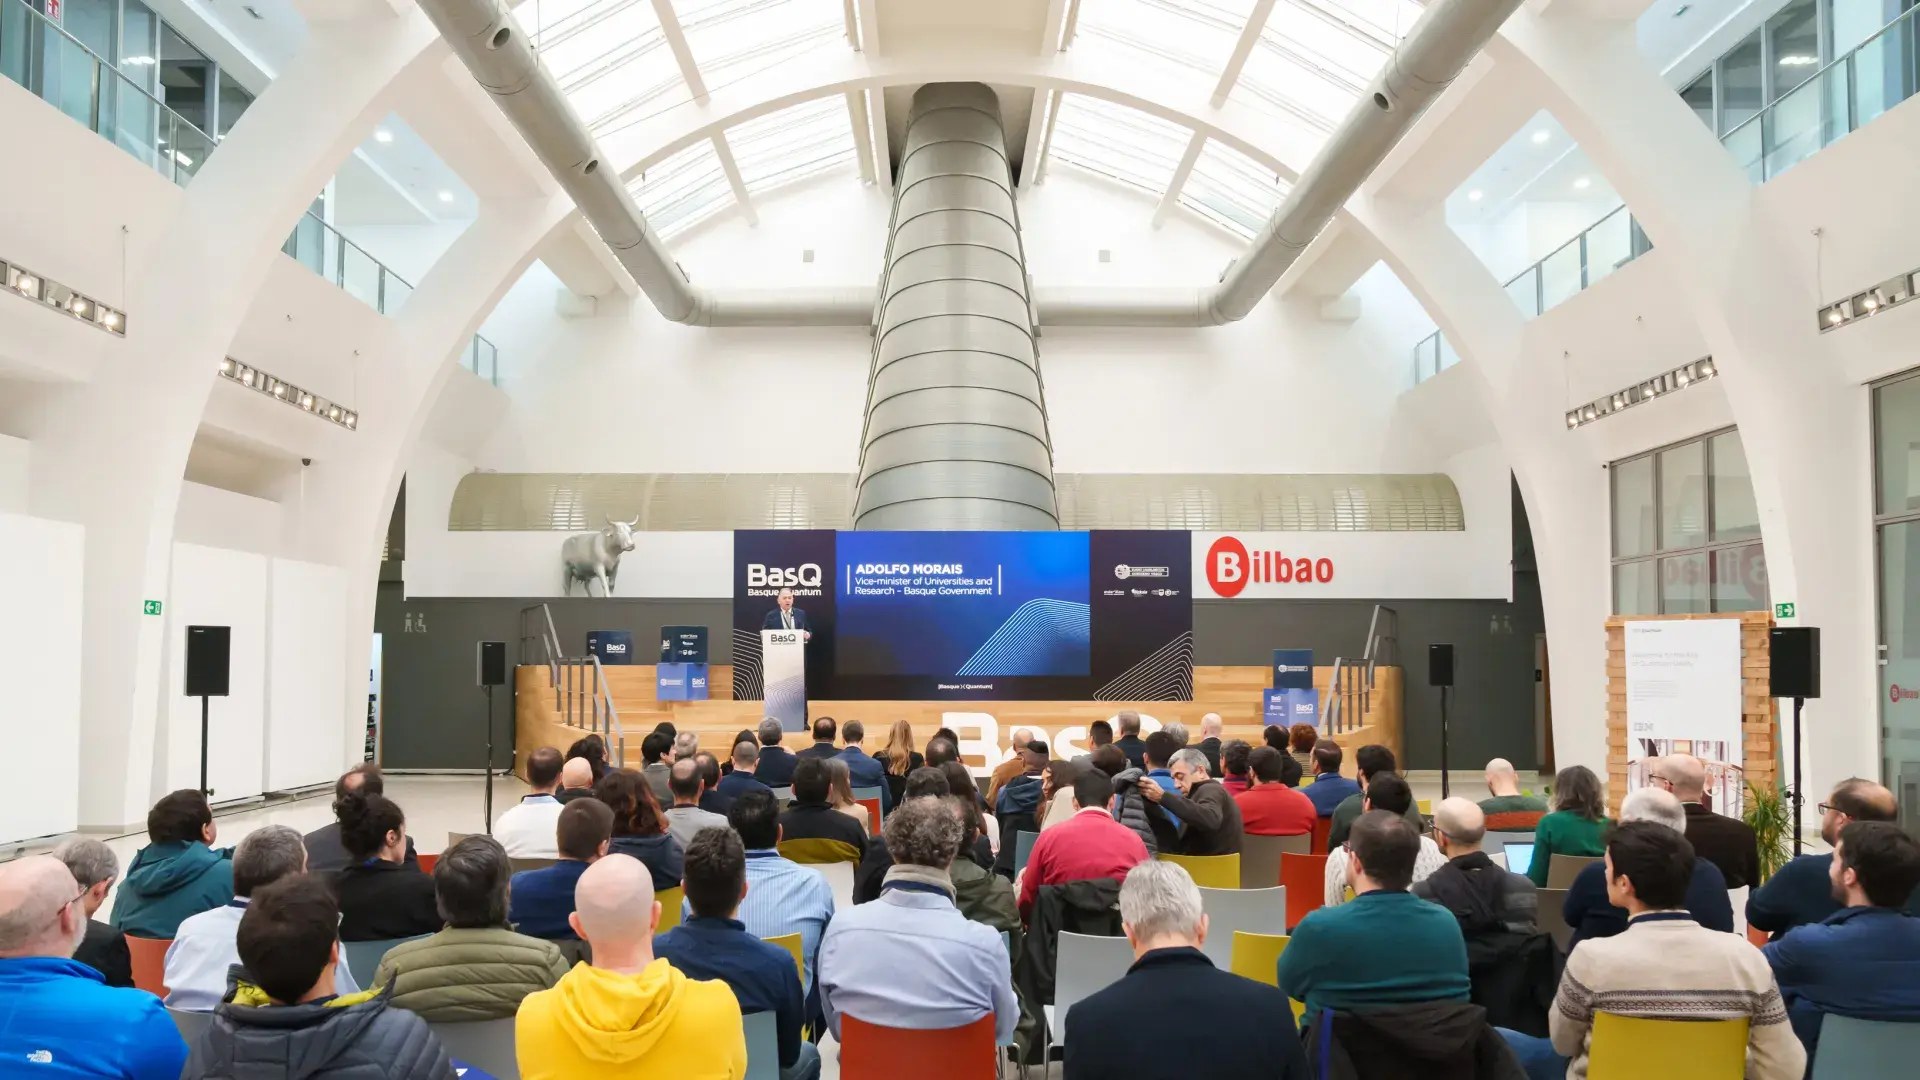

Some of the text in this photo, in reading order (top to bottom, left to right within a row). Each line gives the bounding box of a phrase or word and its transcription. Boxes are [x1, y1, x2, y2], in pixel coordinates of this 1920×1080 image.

[856, 564, 963, 575] ADOLFO MORAIS
[1214, 548, 1335, 585] Bilbao
[747, 563, 822, 587] BasQ
[855, 577, 993, 586] Vice-minister of Universities and
[747, 588, 822, 597] Basque uantum
[855, 587, 895, 595] Research
[904, 587, 936, 596] Basque
[938, 587, 992, 595] Government
[771, 634, 796, 642] BasQ
